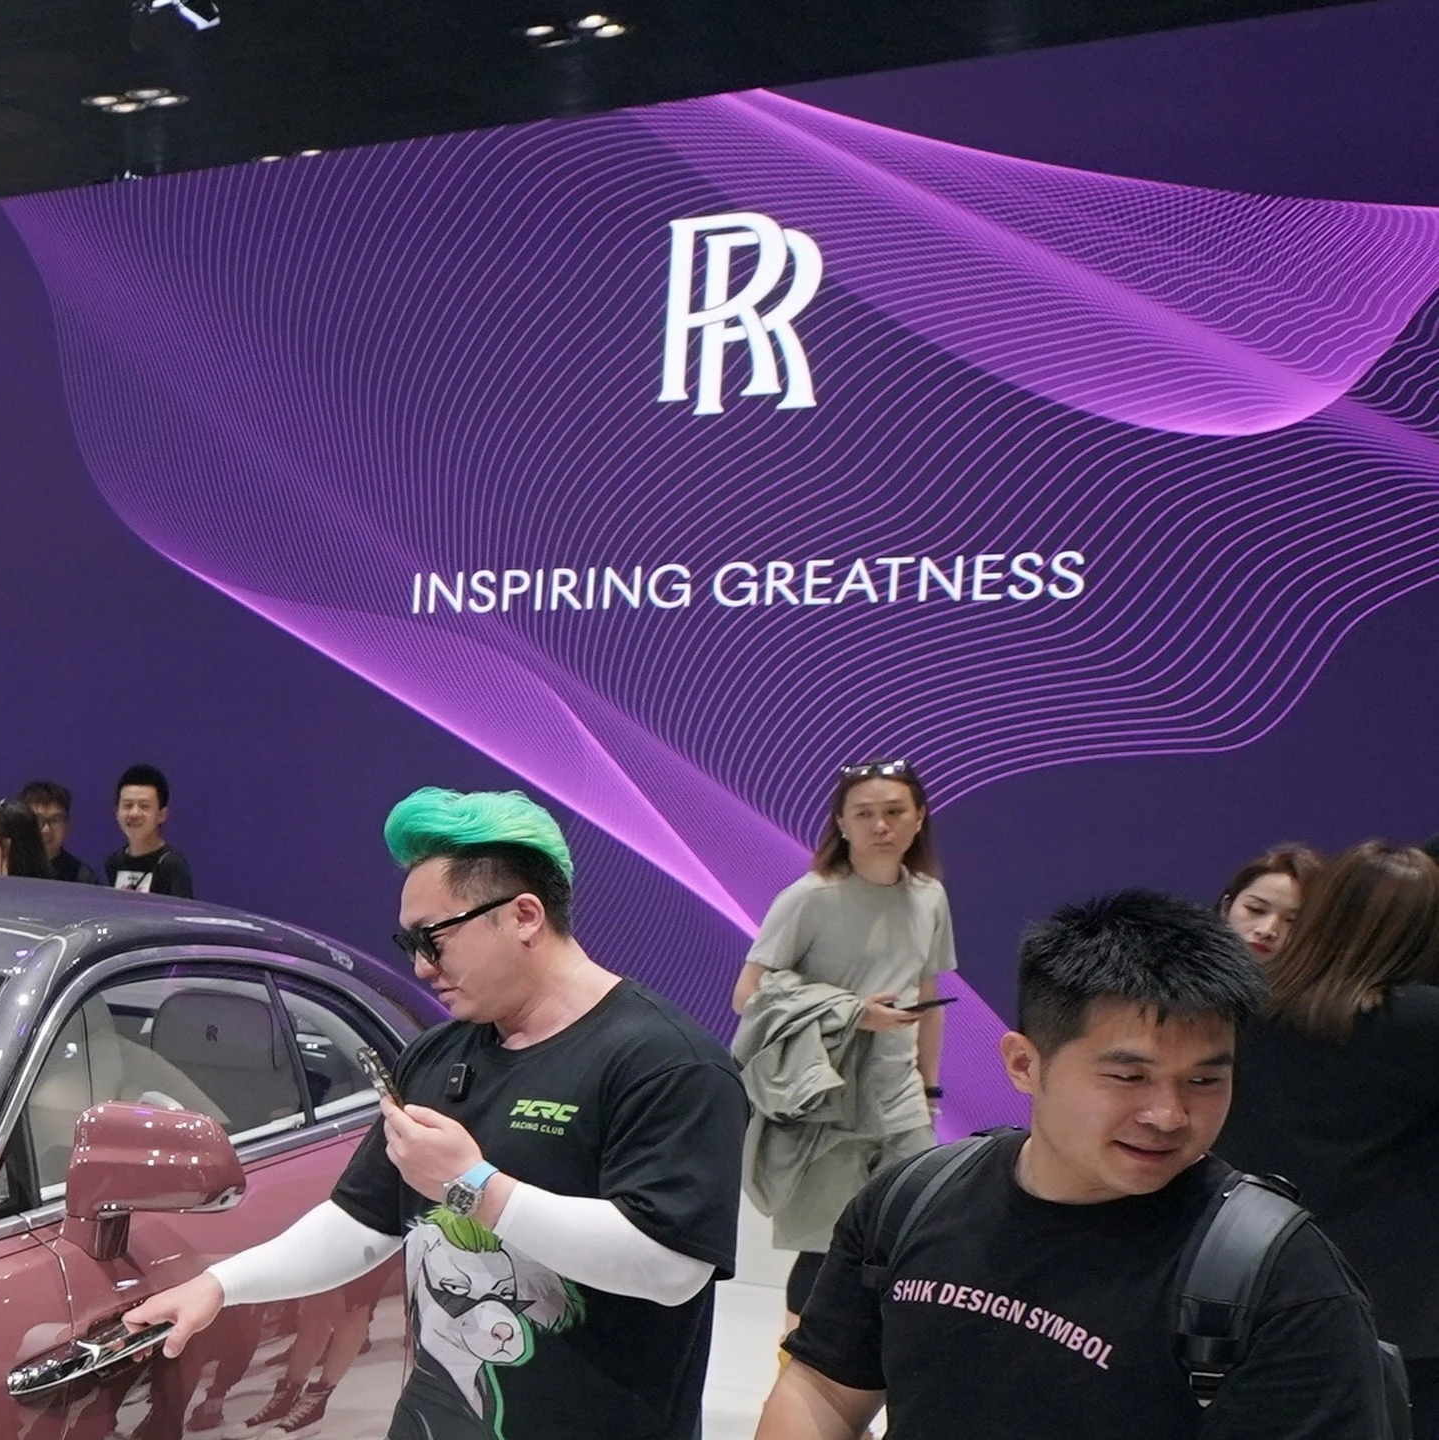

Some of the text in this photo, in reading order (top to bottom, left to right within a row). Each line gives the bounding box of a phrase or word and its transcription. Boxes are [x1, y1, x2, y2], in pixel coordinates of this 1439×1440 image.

[411, 551, 1086, 614] INSPIRING GREATNESS
[509, 1121, 564, 1136] RACING CLUB
[892, 1280, 1113, 1370] SHIK DESIGN SYMBOL
